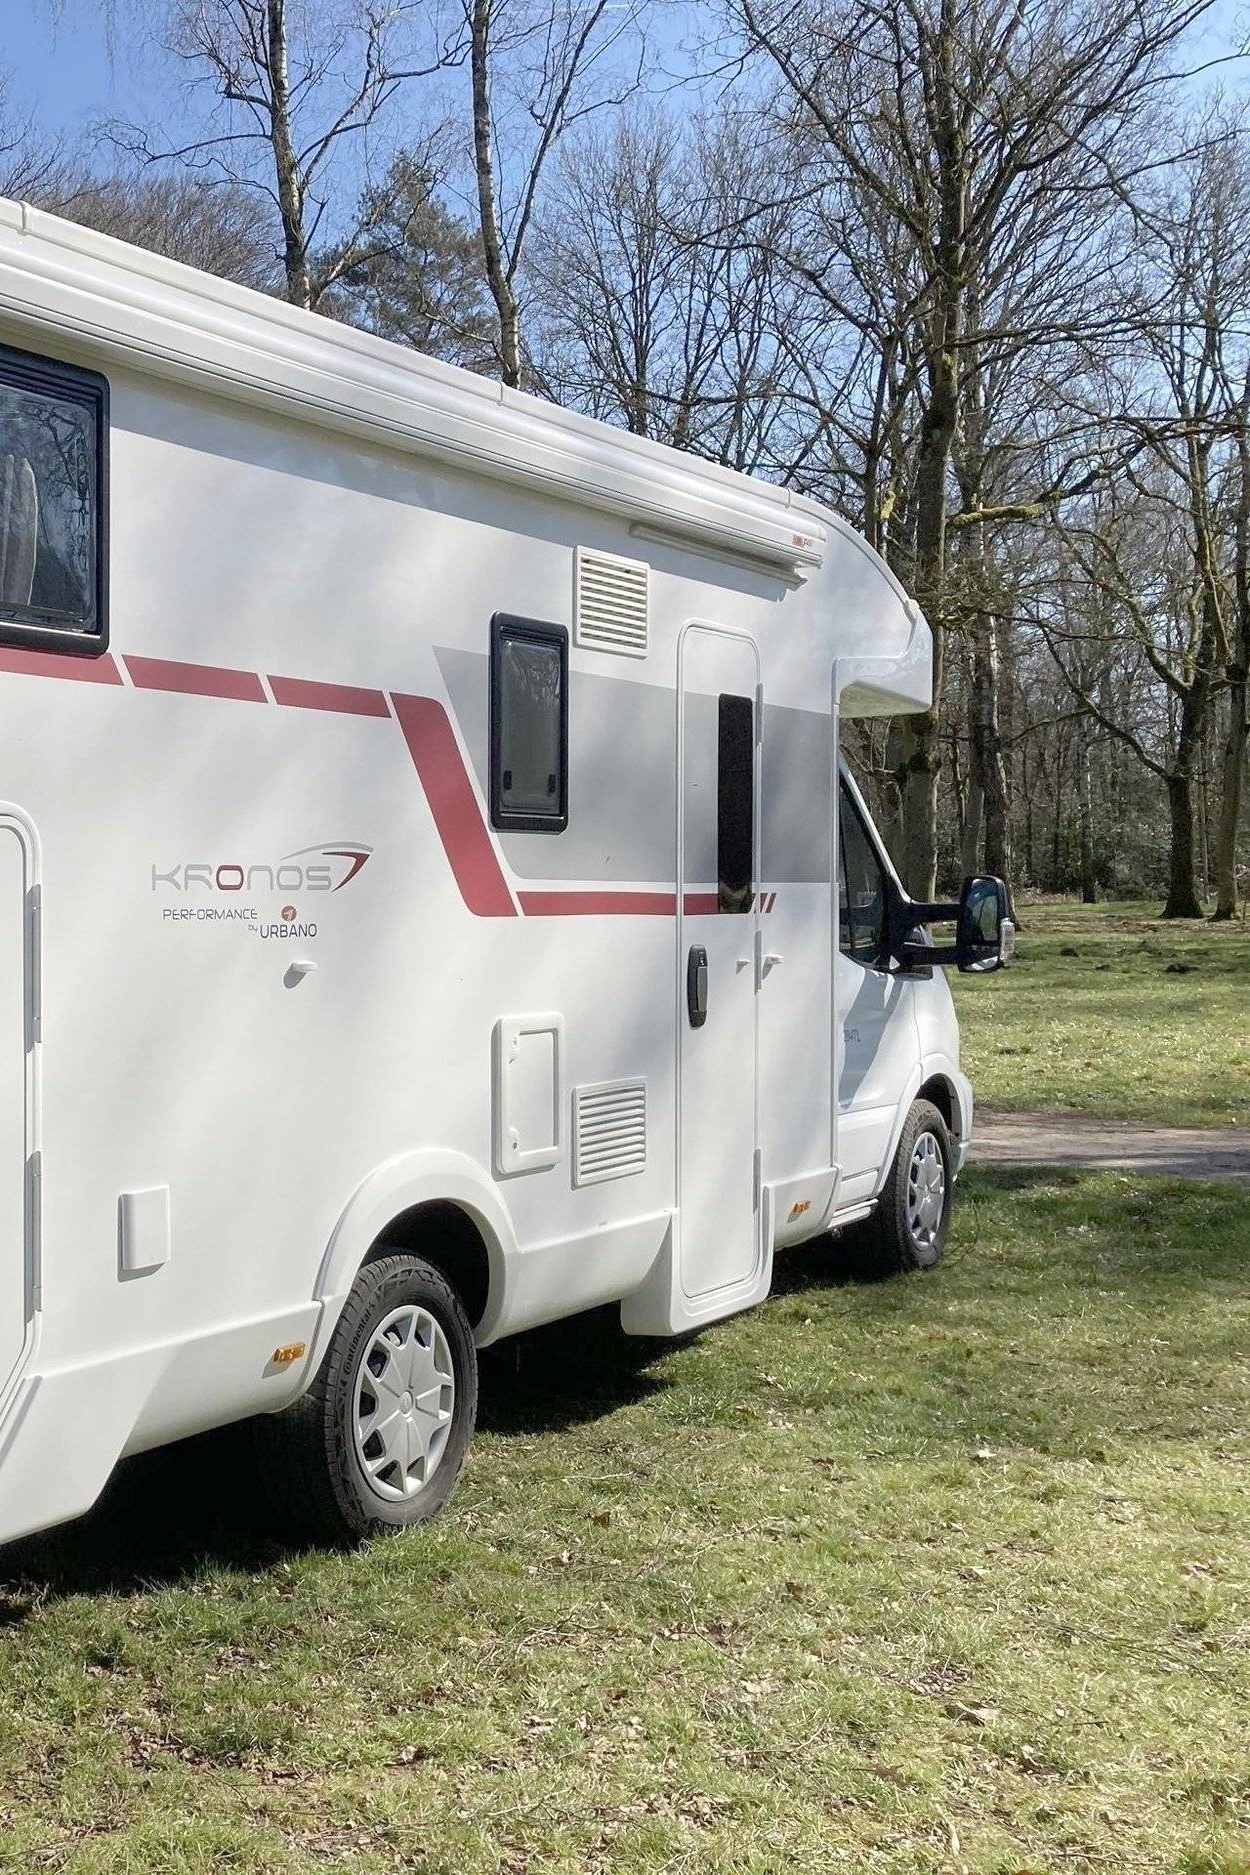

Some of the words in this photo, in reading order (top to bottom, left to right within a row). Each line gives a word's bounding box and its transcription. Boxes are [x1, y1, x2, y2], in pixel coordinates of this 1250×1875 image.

[151, 863, 333, 892] KRONOS
[162, 907, 258, 921] PERFORMANCE
[260, 923, 318, 939] URBANO
